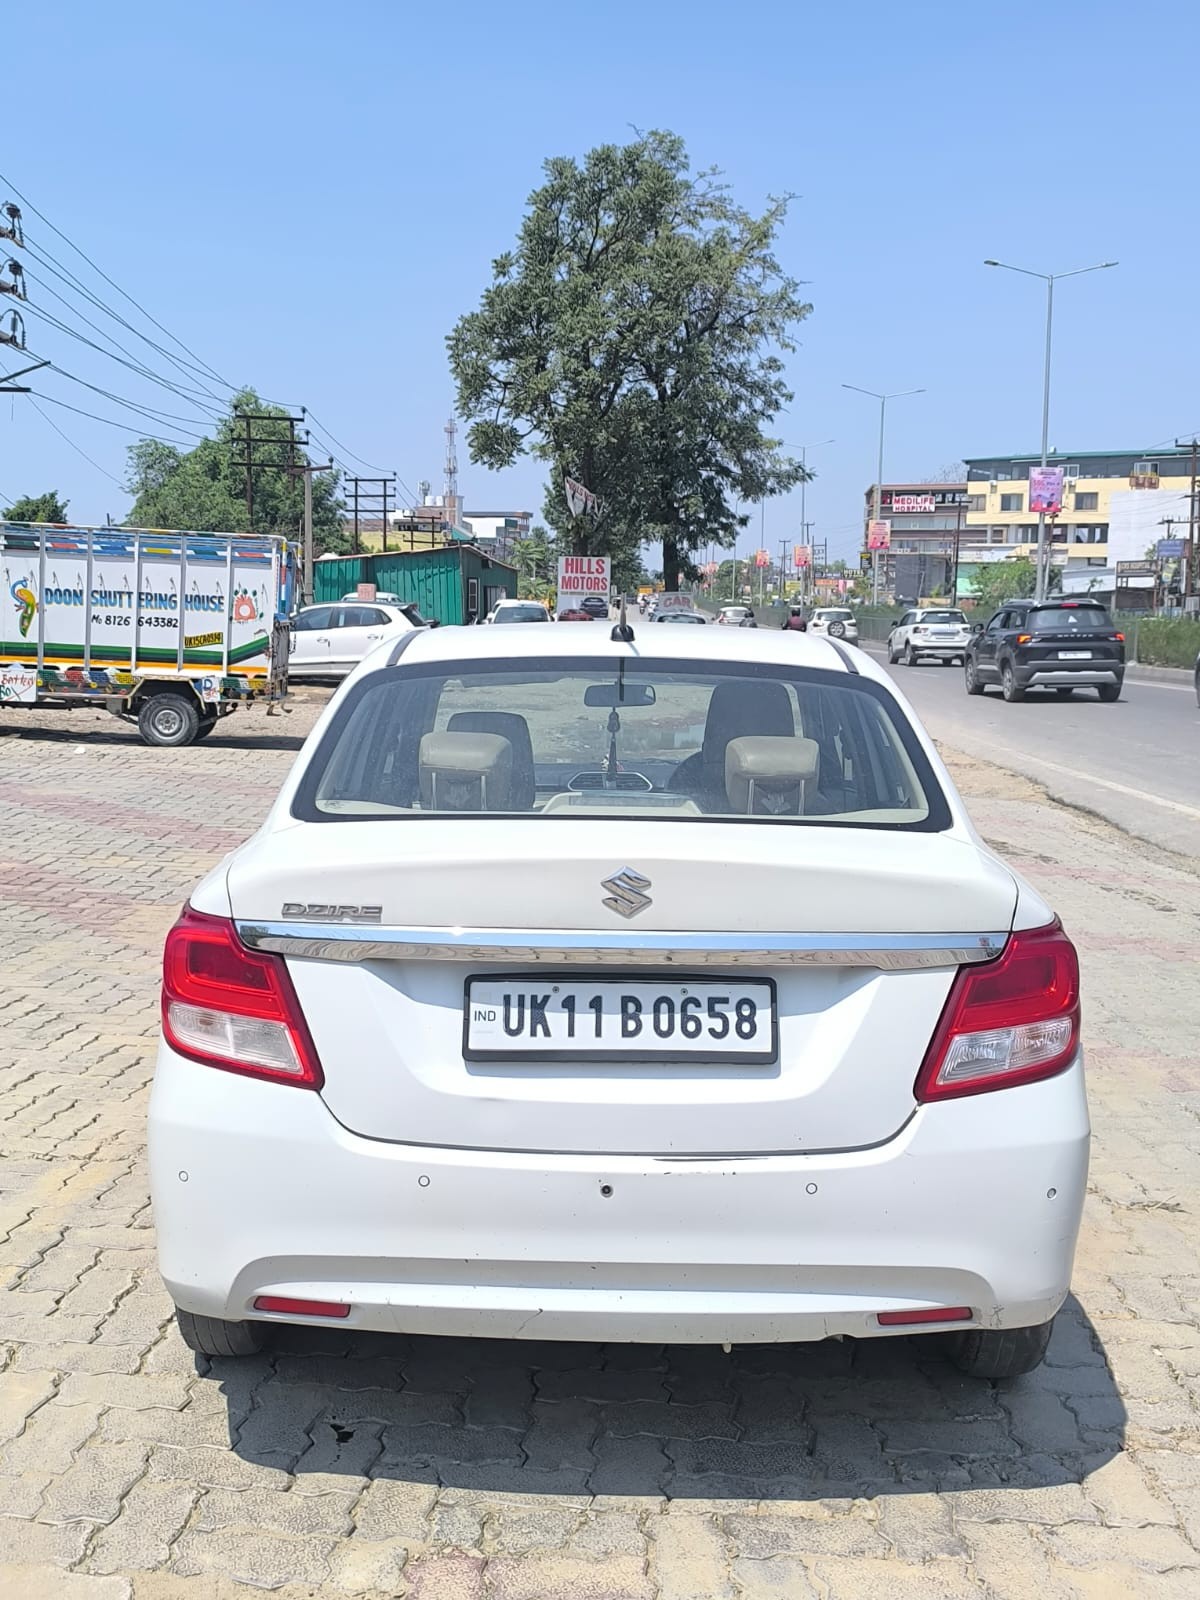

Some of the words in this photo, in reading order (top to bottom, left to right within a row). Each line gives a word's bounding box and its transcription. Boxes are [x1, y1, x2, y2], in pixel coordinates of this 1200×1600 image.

[893, 496, 935, 505] MEDILIFE
[564, 557, 606, 575] HILLS
[560, 575, 608, 591] MOTORS
[45, 587, 84, 607] DOON
[184, 593, 225, 613] HOUSE
[104, 614, 132, 627] 8126
[137, 616, 179, 629] 643382
[281, 902, 382, 922] DZIRE
[473, 1009, 497, 1023] IND
